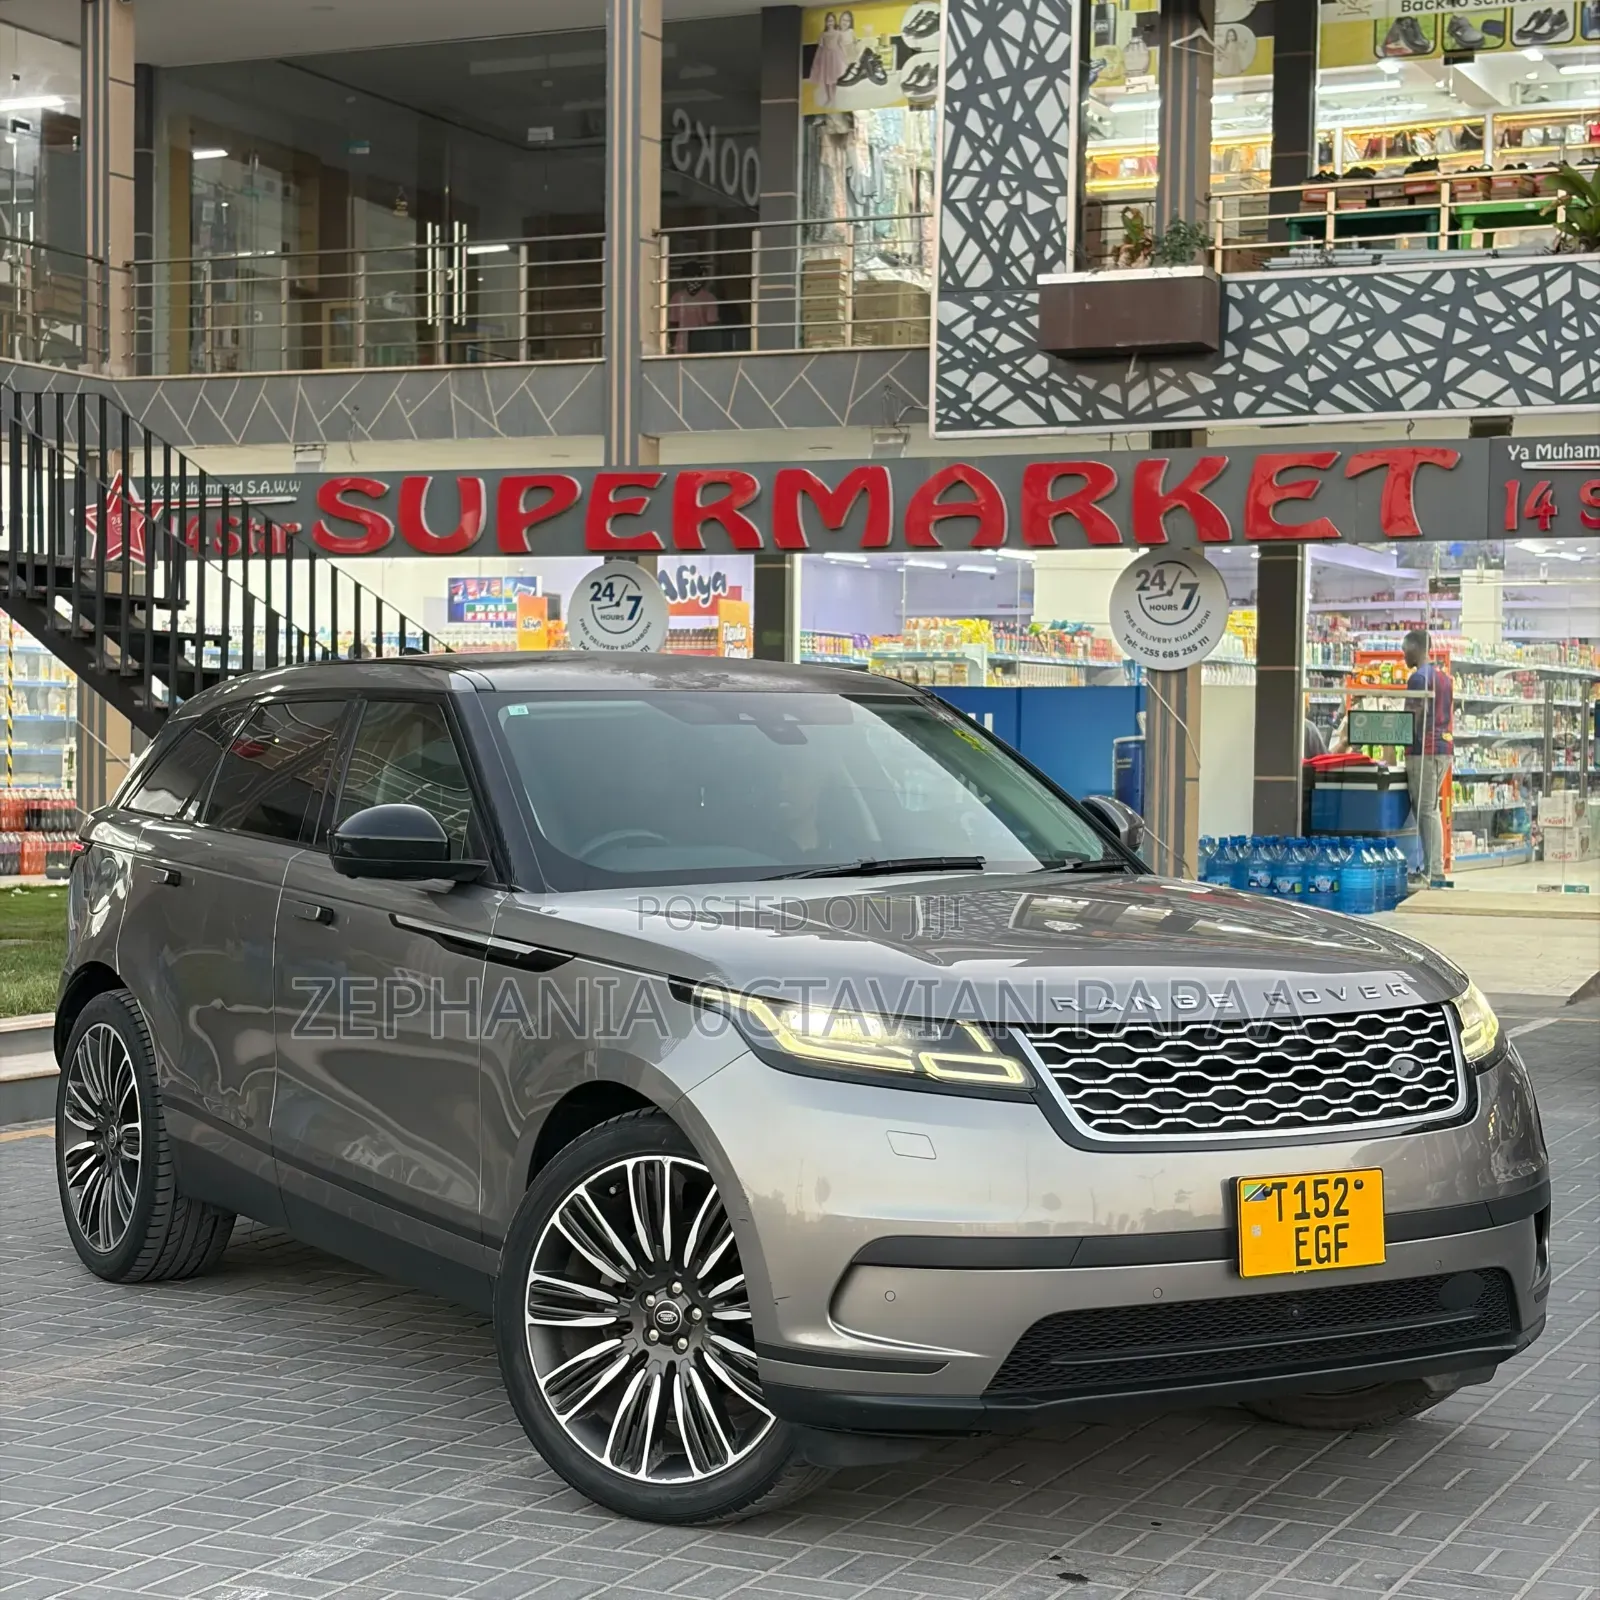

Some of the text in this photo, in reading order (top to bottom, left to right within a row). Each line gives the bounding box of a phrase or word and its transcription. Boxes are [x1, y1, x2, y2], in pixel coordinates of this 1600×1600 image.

[1507, 444, 1529, 461] Ya
[170, 481, 243, 495] Muhmmad
[312, 446, 1461, 555] SUPERMARKET
[1504, 480, 1558, 531] 14
[1124, 609, 1211, 644] FREE DELIVERY KIGAMBONI
[589, 635, 619, 650] DELIVERY
[1123, 634, 1138, 649] Tel:
[1139, 646, 1160, 658] +255
[1162, 650, 1180, 658] 685
[1182, 645, 1198, 656] 255
[1050, 981, 1411, 1012] RANGE ROVER
[1294, 1223, 1350, 1267] EGF
